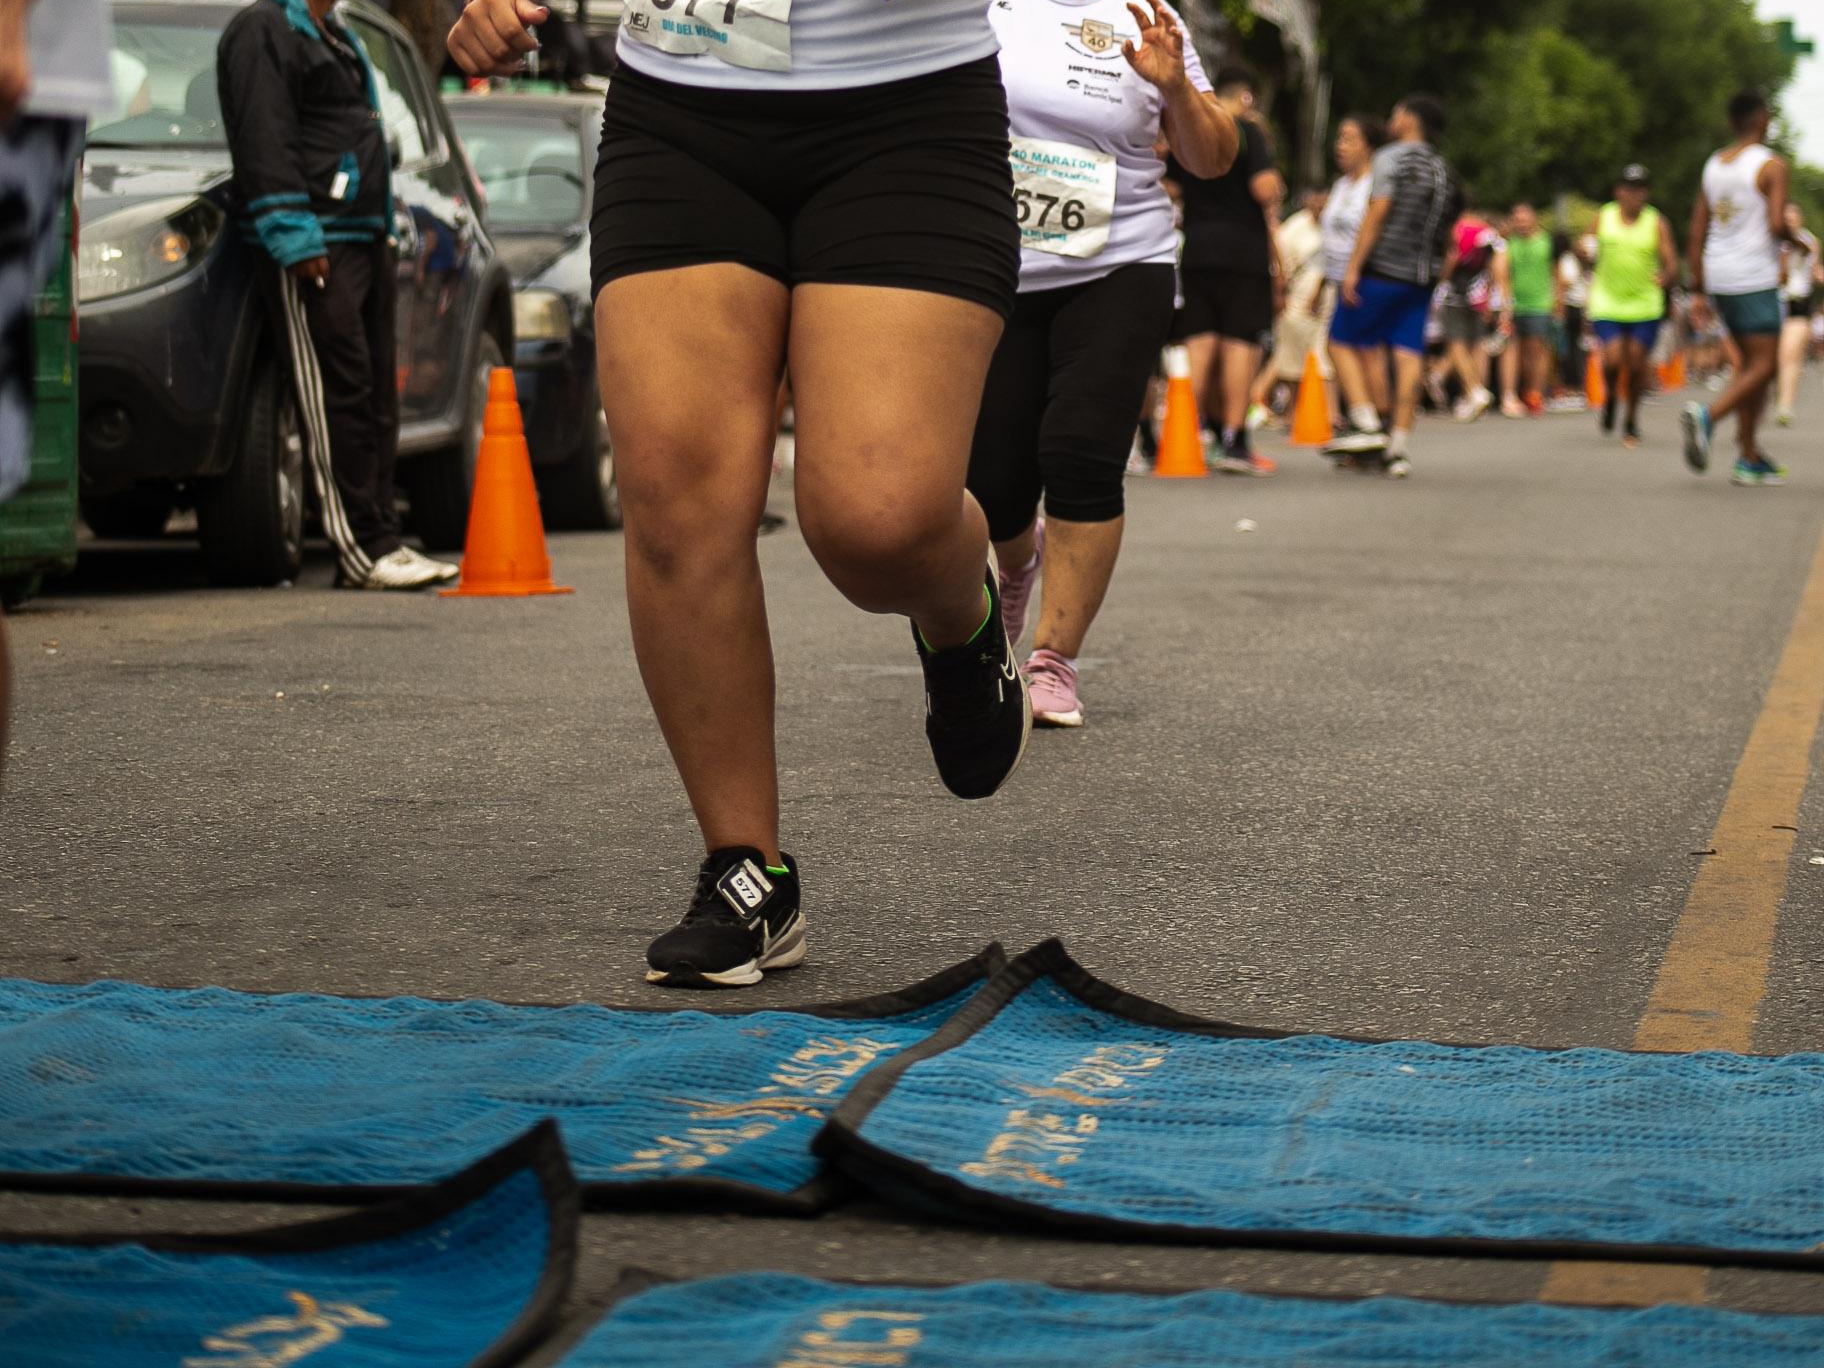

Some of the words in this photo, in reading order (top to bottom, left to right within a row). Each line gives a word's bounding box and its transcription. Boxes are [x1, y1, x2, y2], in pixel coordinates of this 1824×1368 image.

[629, 11, 650, 29] NEJ
[676, 22, 694, 36] DEL
[1088, 37, 1106, 49] 40
[1011, 148, 1028, 161] 40
[1032, 151, 1097, 171] MARATON
[1011, 187, 1085, 232] 576
[736, 877, 756, 900] 577
